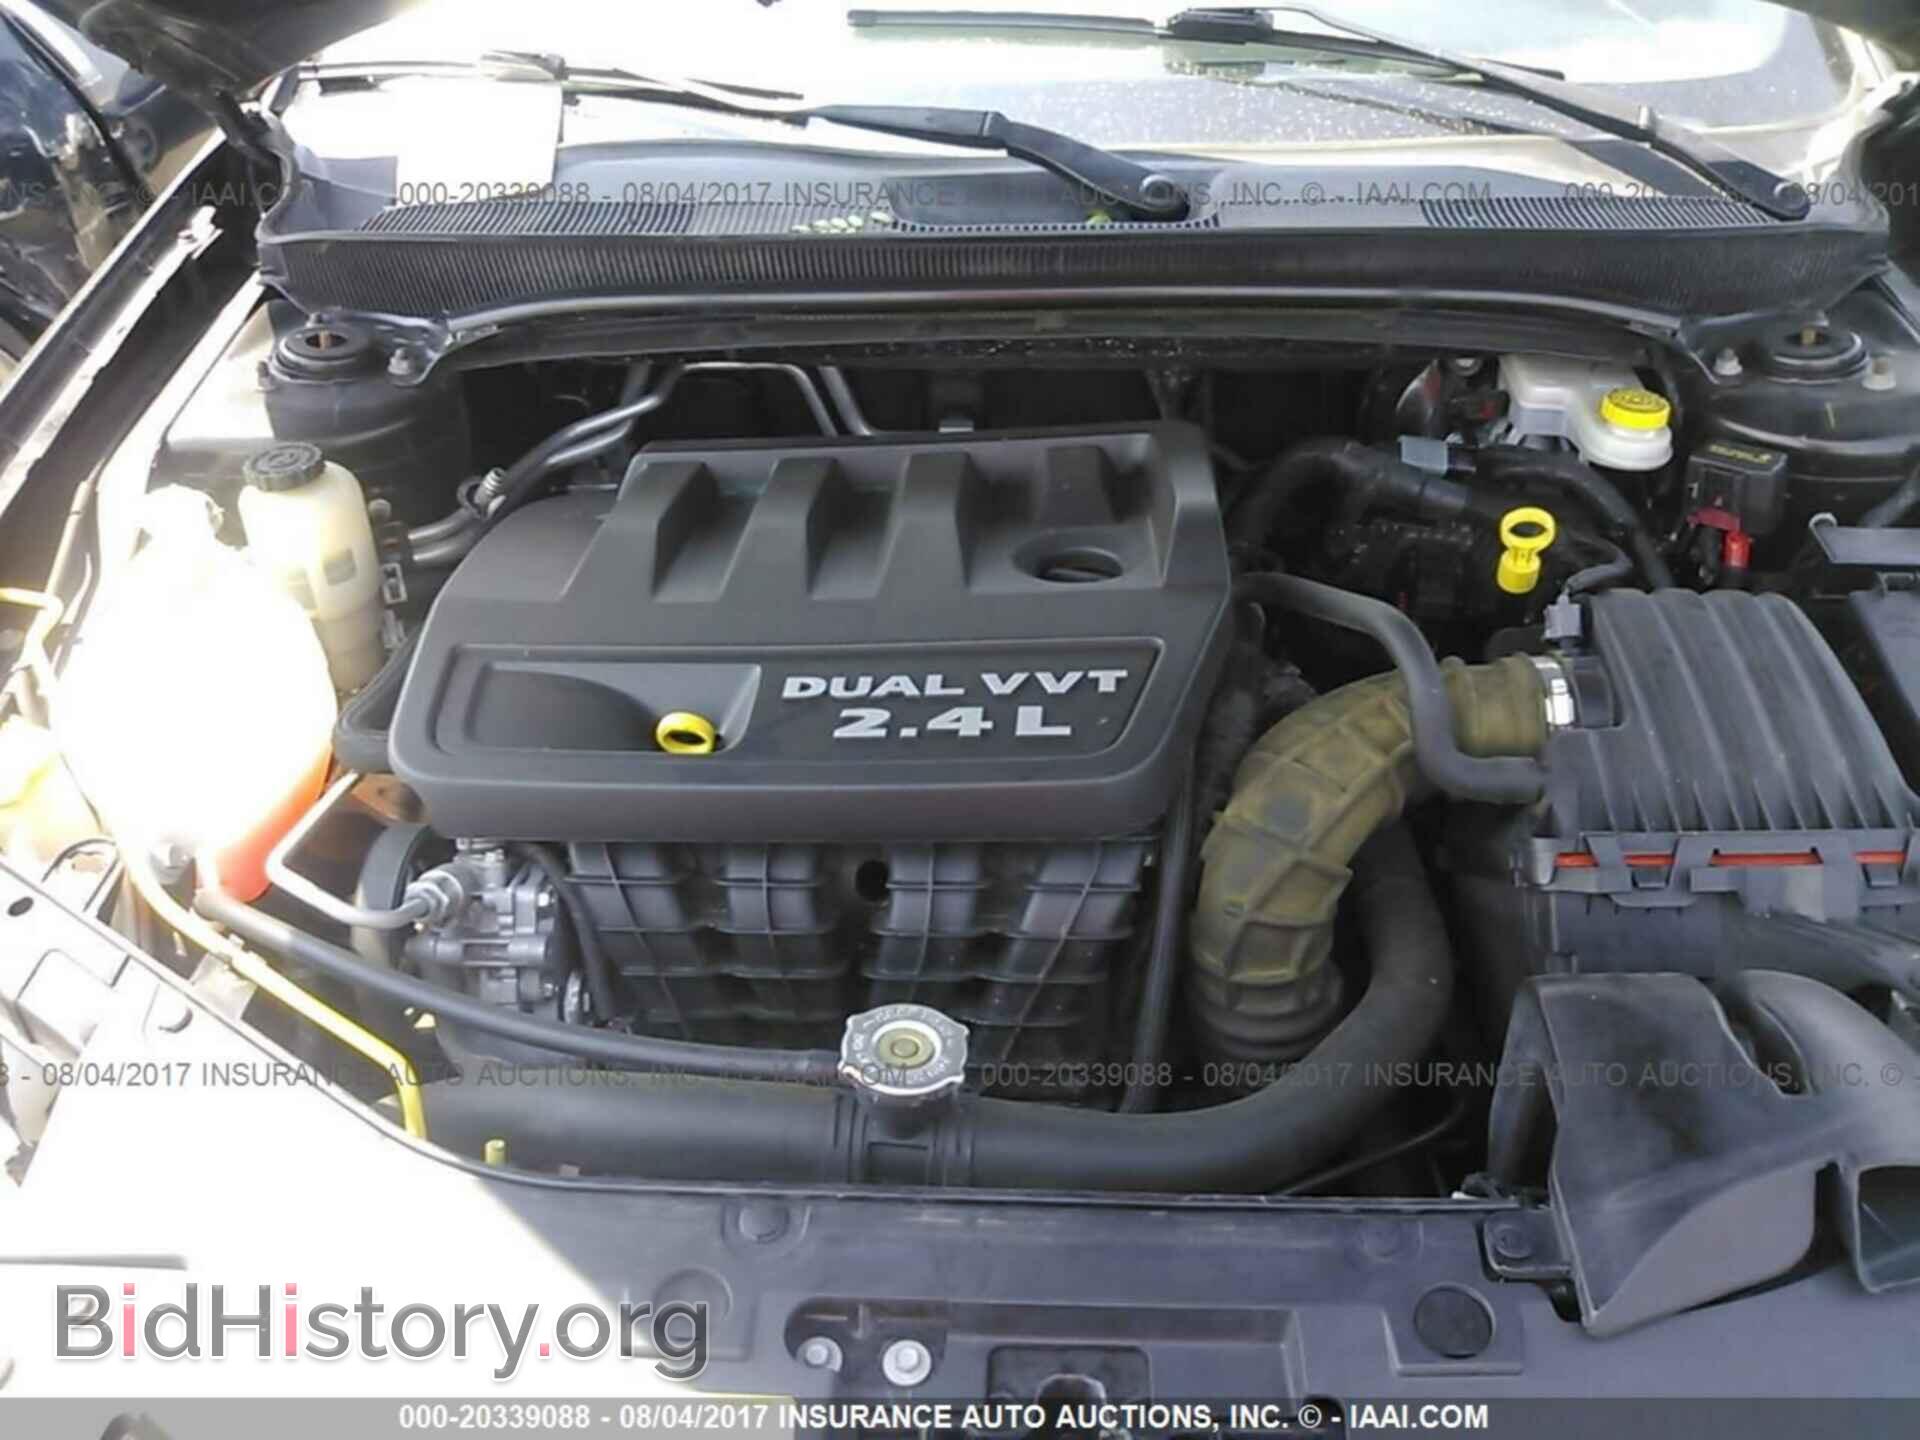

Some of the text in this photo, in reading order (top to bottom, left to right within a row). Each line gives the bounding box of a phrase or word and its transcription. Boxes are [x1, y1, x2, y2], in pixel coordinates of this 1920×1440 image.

[783, 669, 1128, 699] DUAL VVT
[832, 705, 1073, 739] 2.4 L
